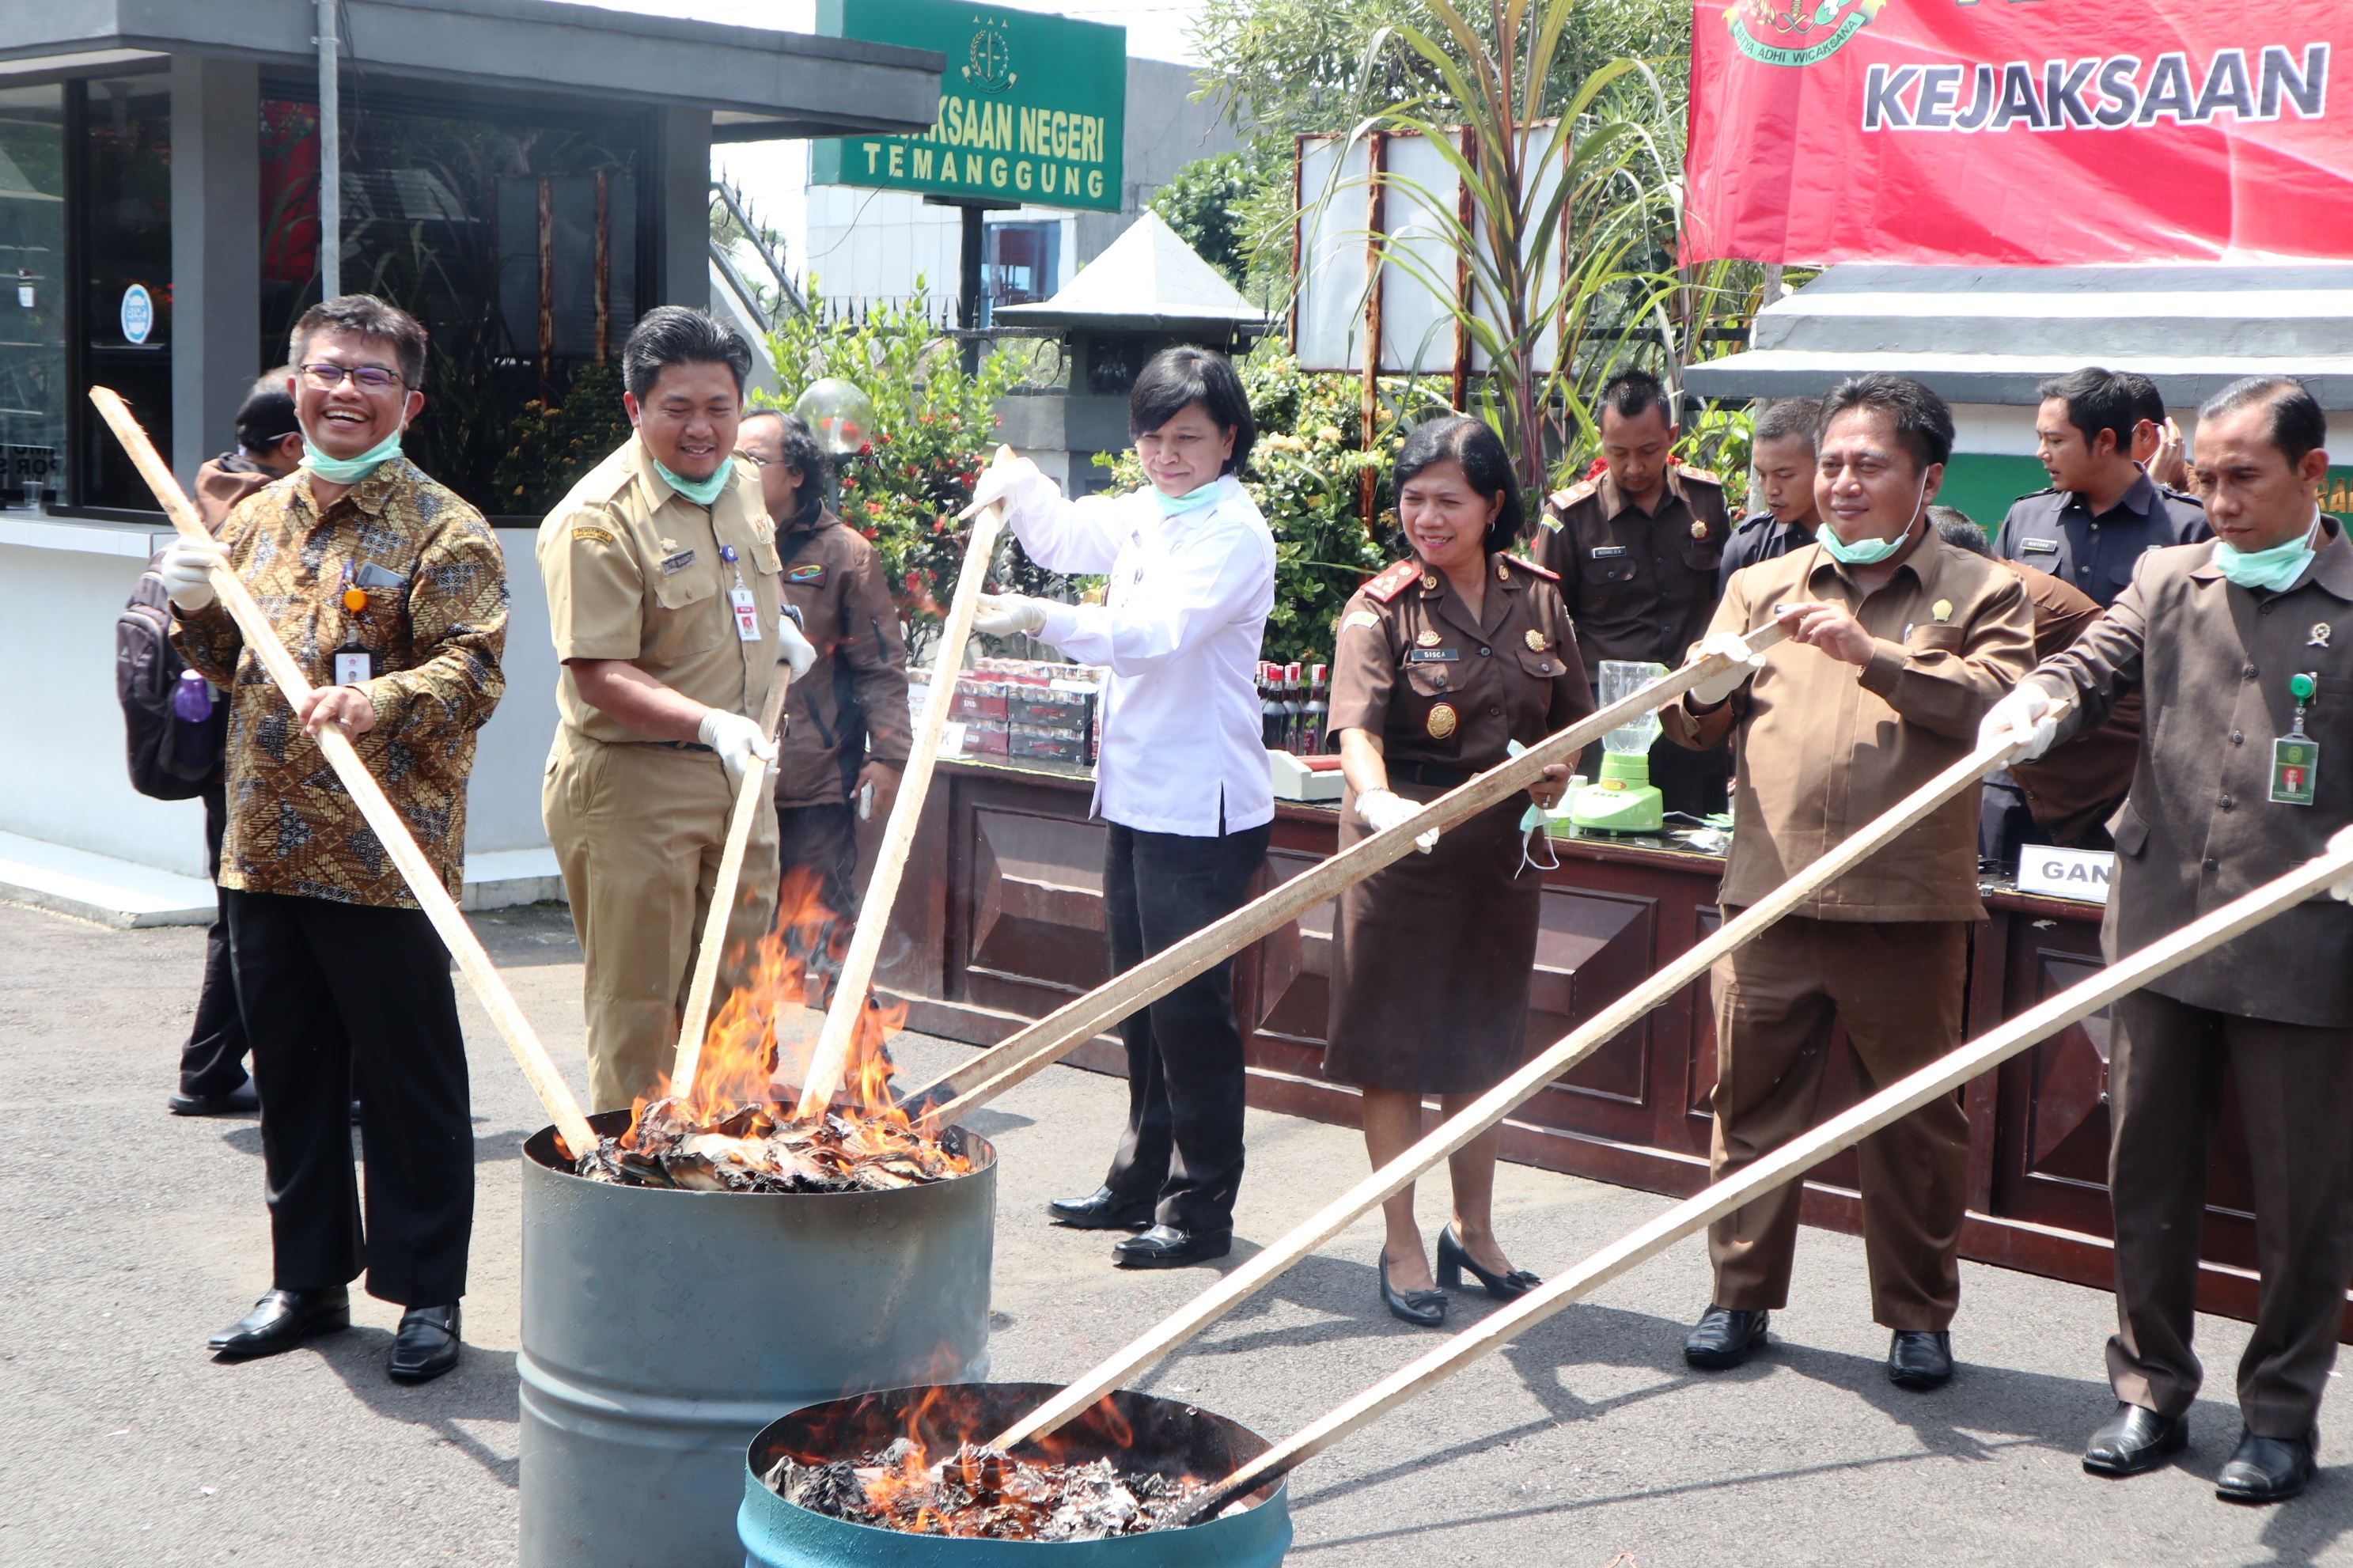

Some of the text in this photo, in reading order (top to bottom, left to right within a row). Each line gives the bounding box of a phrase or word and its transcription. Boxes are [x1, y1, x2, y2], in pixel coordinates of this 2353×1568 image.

[1736, 21, 1858, 62] SATYA ADHI WICAKSANA
[1862, 44, 2330, 131] KEJAKSAAN
[885, 95, 1104, 162] KSAAN NEGERI
[863, 142, 1104, 198] TEMANGGUNG
